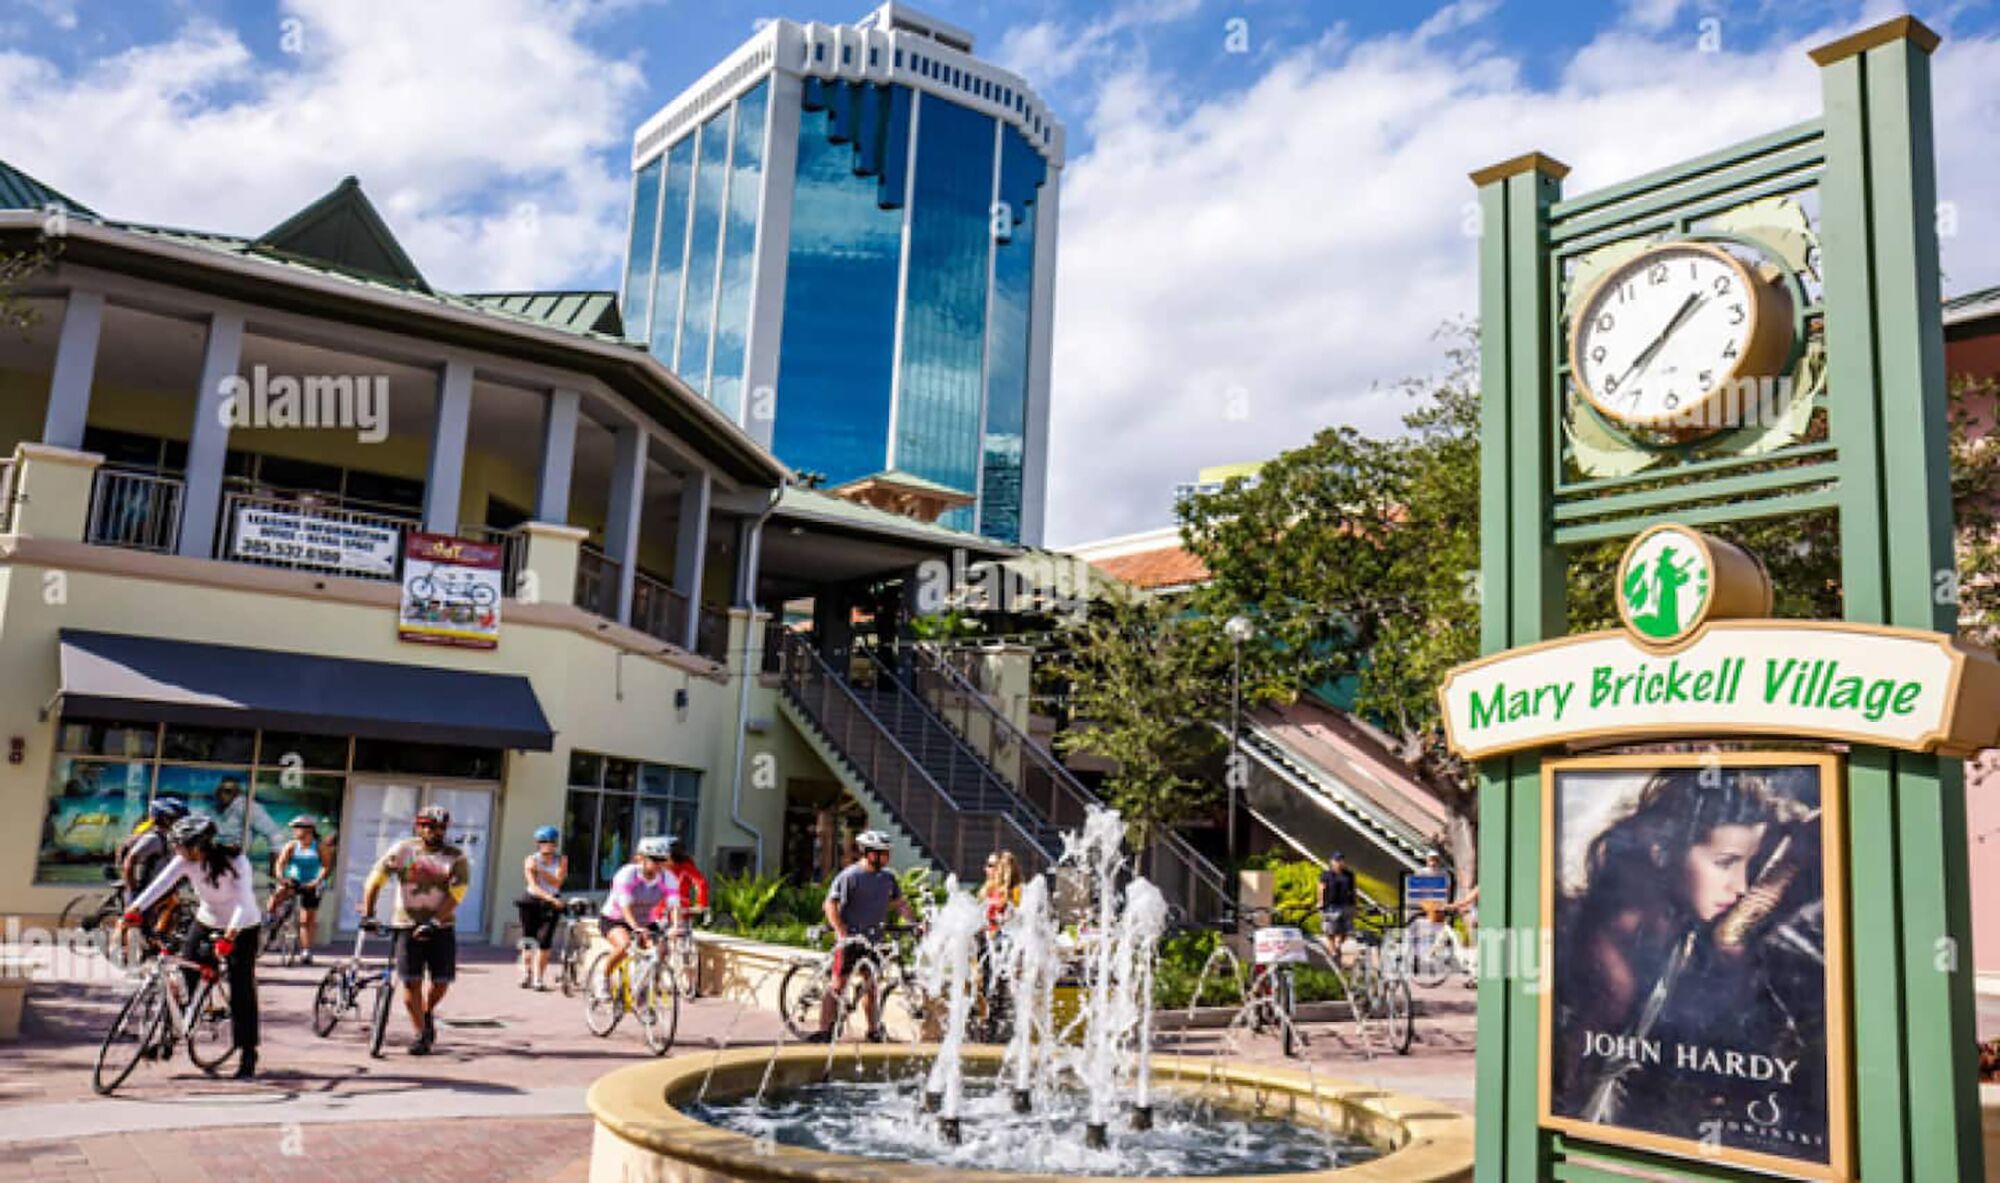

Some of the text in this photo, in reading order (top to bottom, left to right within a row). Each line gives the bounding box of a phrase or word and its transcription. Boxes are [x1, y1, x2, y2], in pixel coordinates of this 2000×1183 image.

[1648, 263, 1669, 286] 12
[1690, 262, 1698, 280] 1
[1617, 283, 1635, 304] 11
[1714, 275, 1731, 297] 2
[1596, 312, 1615, 334] 10
[1728, 303, 1745, 325] 3
[1592, 346, 1606, 364] 9
[1722, 339, 1737, 359] 4
[1604, 373, 1618, 395] 8
[1700, 369, 1713, 392] 5
[1631, 389, 1642, 411] 7
[1664, 388, 1679, 410] 6
[1469, 656, 1923, 731] Mary Brickell Village
[1583, 1030, 1799, 1085] JOHN HARDY
